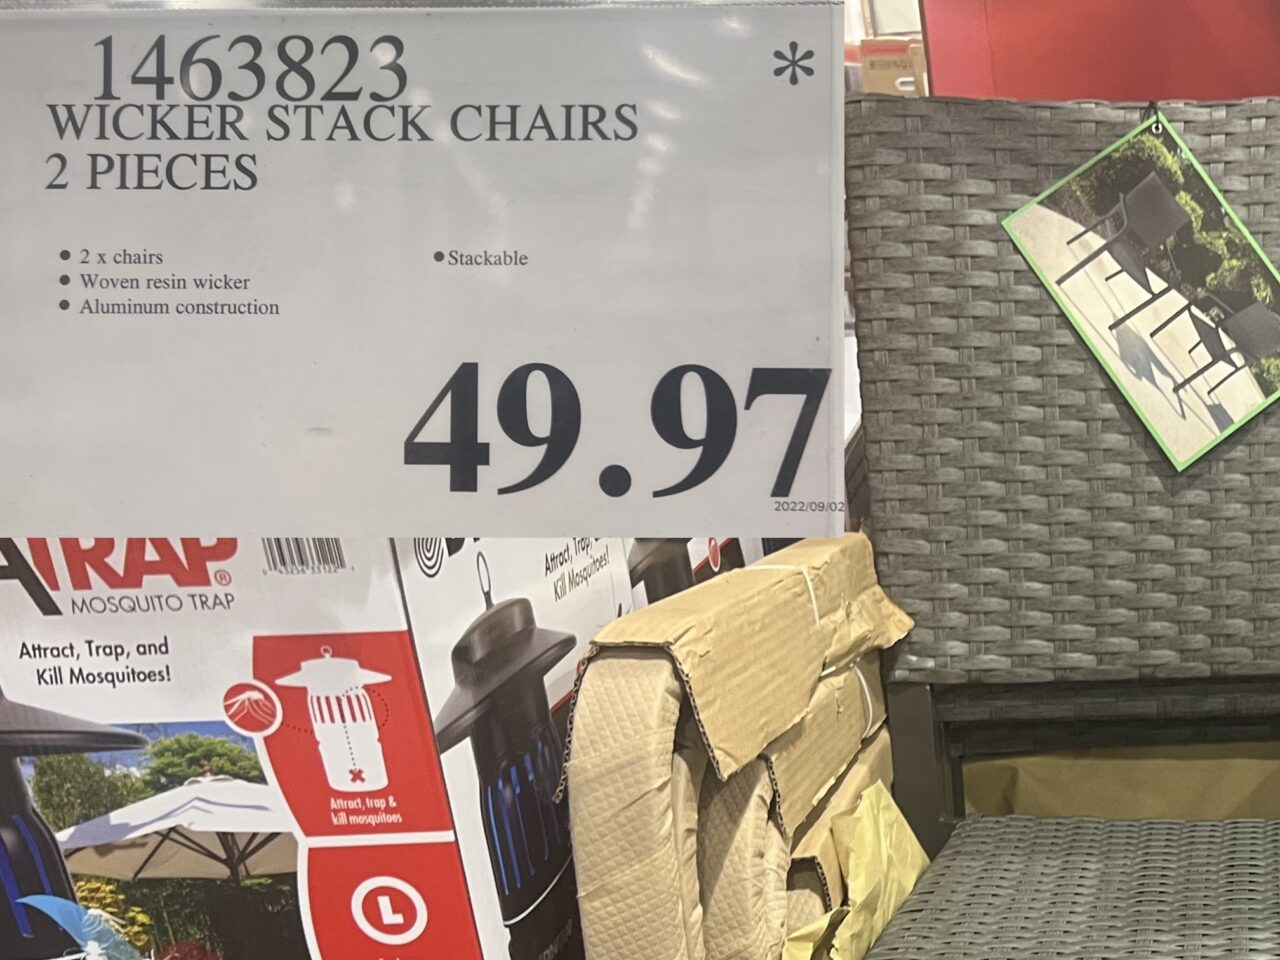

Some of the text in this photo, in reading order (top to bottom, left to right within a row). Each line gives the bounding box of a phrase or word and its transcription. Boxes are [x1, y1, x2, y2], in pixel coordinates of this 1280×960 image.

[93, 34, 409, 102] 1463823
[47, 103, 639, 142] WICKER STACK CHAIRS
[44, 152, 258, 191] 2 PIECES
[79, 249, 164, 265] 2 x chairs
[448, 249, 529, 266] Stackable
[80, 273, 250, 290] Woven resin wicker
[79, 298, 280, 315] Aluminum construction
[403, 362, 833, 499] 49.97
[774, 501, 845, 512] 2022/09/02
[553, 544, 610, 602] Kill Mosquitoes!
[71, 592, 235, 614] MOSQUITO TRAP
[19, 635, 170, 662] Attract, Trap, and
[36, 664, 172, 689] Kill Mosquitoes!
[350, 812, 402, 827] mosquitoes
[377, 895, 405, 925] L
